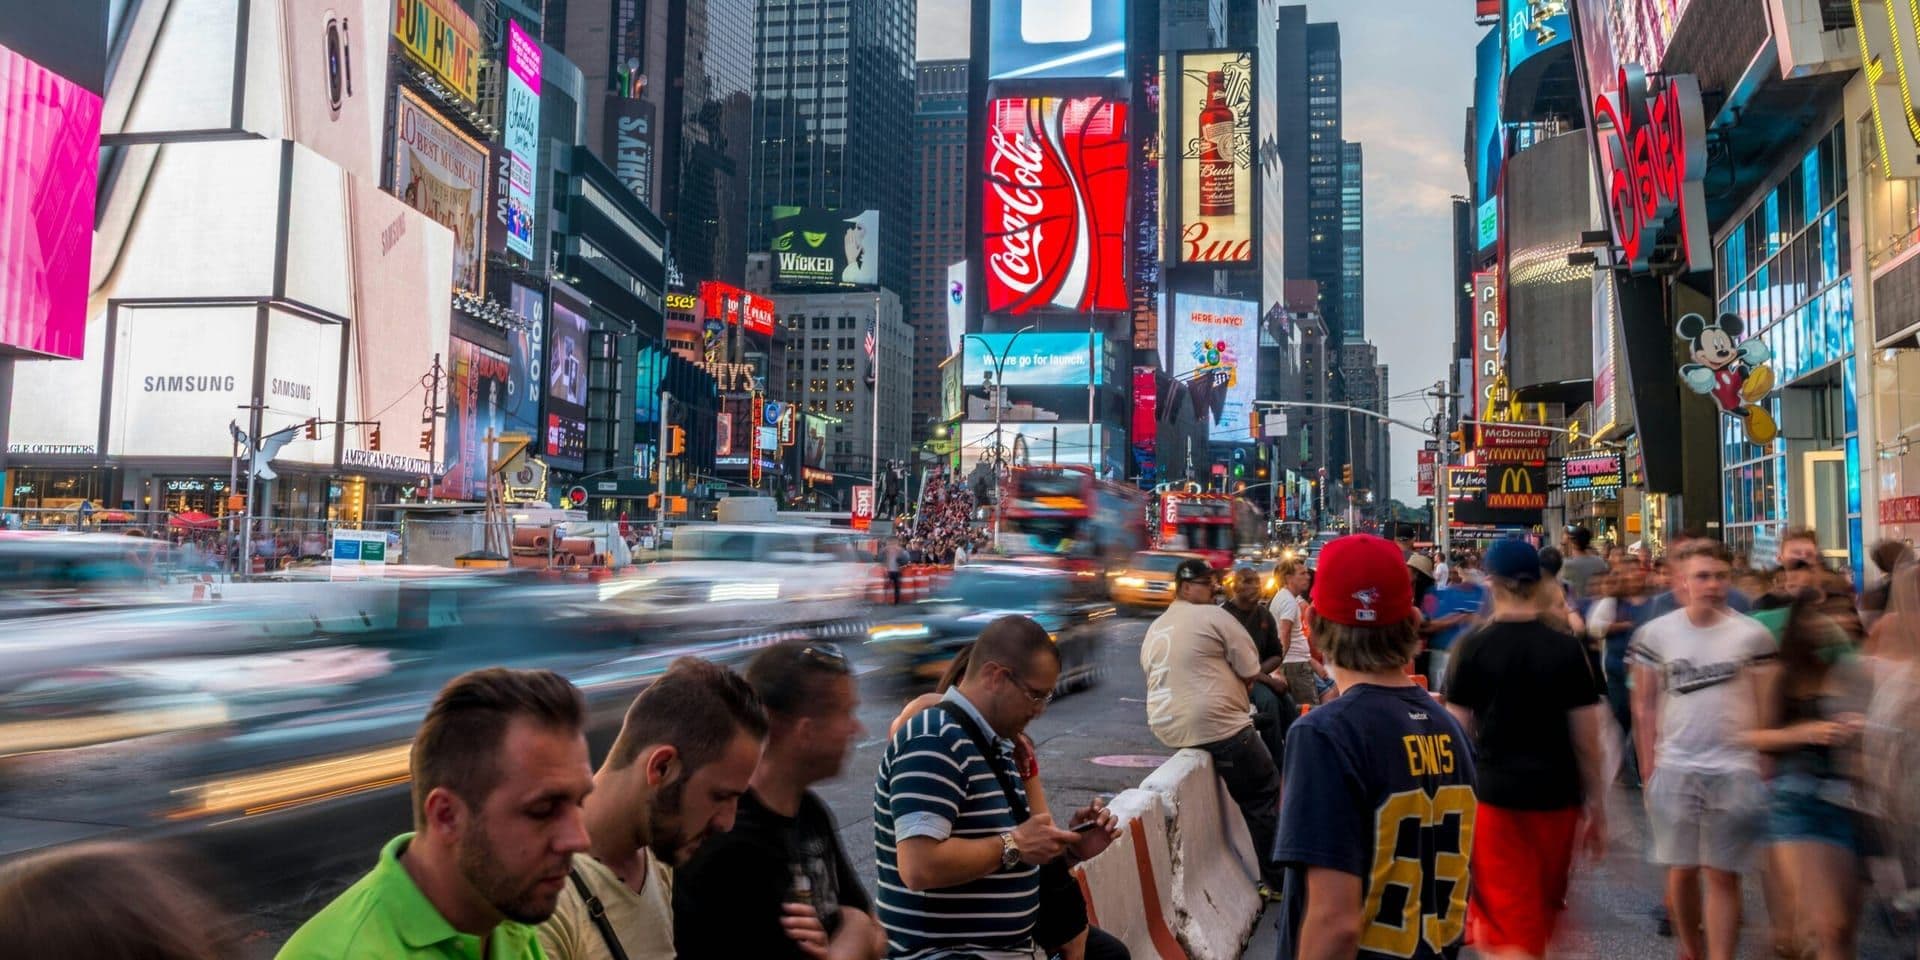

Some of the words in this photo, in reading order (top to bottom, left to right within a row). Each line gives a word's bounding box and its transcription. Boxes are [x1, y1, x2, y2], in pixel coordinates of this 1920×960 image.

[396, 0, 429, 57] FUN
[433, 15, 473, 96] HOME
[400, 104, 416, 146] 10
[416, 132, 438, 163] BEST
[617, 115, 648, 205] SHEY'S
[1593, 64, 1691, 270] Disney
[496, 155, 511, 226] NEW
[990, 124, 1044, 294] Coca-Cola
[666, 294, 696, 310] ese's
[1191, 312, 1213, 324] HERE
[1223, 317, 1243, 327] NYC!
[529, 301, 543, 382] SOLO
[1483, 286, 1496, 399] PALAC
[1001, 356, 1016, 366] are
[1019, 356, 1031, 369] go
[1033, 353, 1047, 366] for
[1049, 353, 1085, 366] launch.
[143, 375, 235, 392] SAMSUNG
[272, 378, 311, 400] SAMSUNG
[528, 383, 539, 402] 2
[1485, 429, 1548, 438] McDonald's
[32, 444, 95, 455] OUTFITTERS
[343, 449, 384, 470] AMERICAN
[406, 457, 444, 476] OUTFIERS
[1567, 458, 1618, 476] ELECTRONICS
[1567, 476, 1591, 487] CAMERA
[1592, 475, 1618, 486] LUGGAGE
[1402, 733, 1455, 777] ENNIS
[1358, 783, 1478, 958] 63
